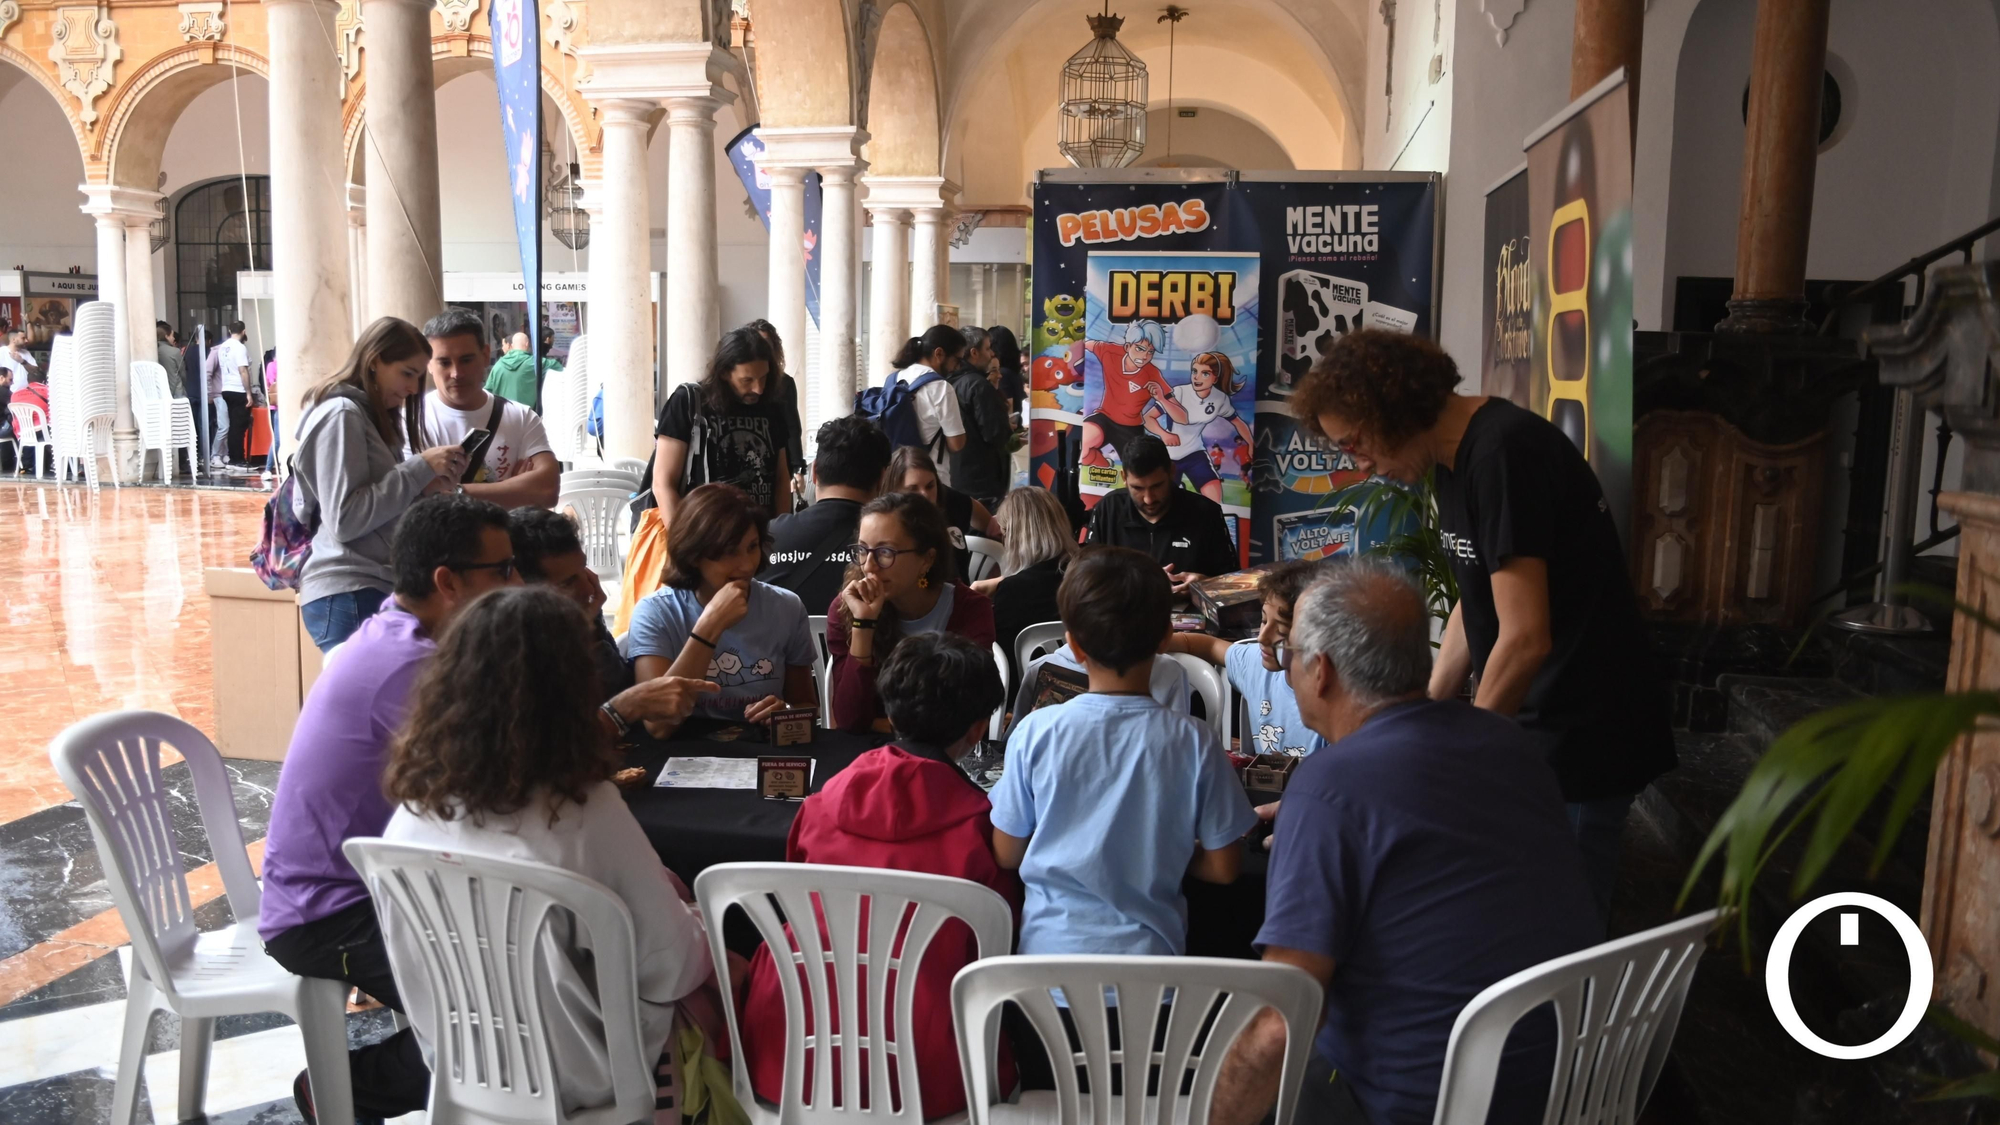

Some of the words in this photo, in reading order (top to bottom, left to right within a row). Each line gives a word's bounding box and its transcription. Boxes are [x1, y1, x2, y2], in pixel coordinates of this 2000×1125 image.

[1057, 199, 1209, 246] PELUSAS
[1286, 204, 1379, 235] MENTE
[1287, 233, 1379, 254] vacuna
[1340, 254, 1347, 262] el
[57, 282, 75, 290] AQUI
[512, 283, 552, 291] LONG
[1110, 271, 1235, 319] DERBI
[1332, 283, 1362, 299] MENTE
[1332, 294, 1361, 306] vacuna
[708, 415, 774, 453] SPEEDER
[1276, 453, 1358, 475] VOLTA
[1290, 532, 1350, 555] VOLTAJE
[1298, 526, 1329, 541] ALTO
